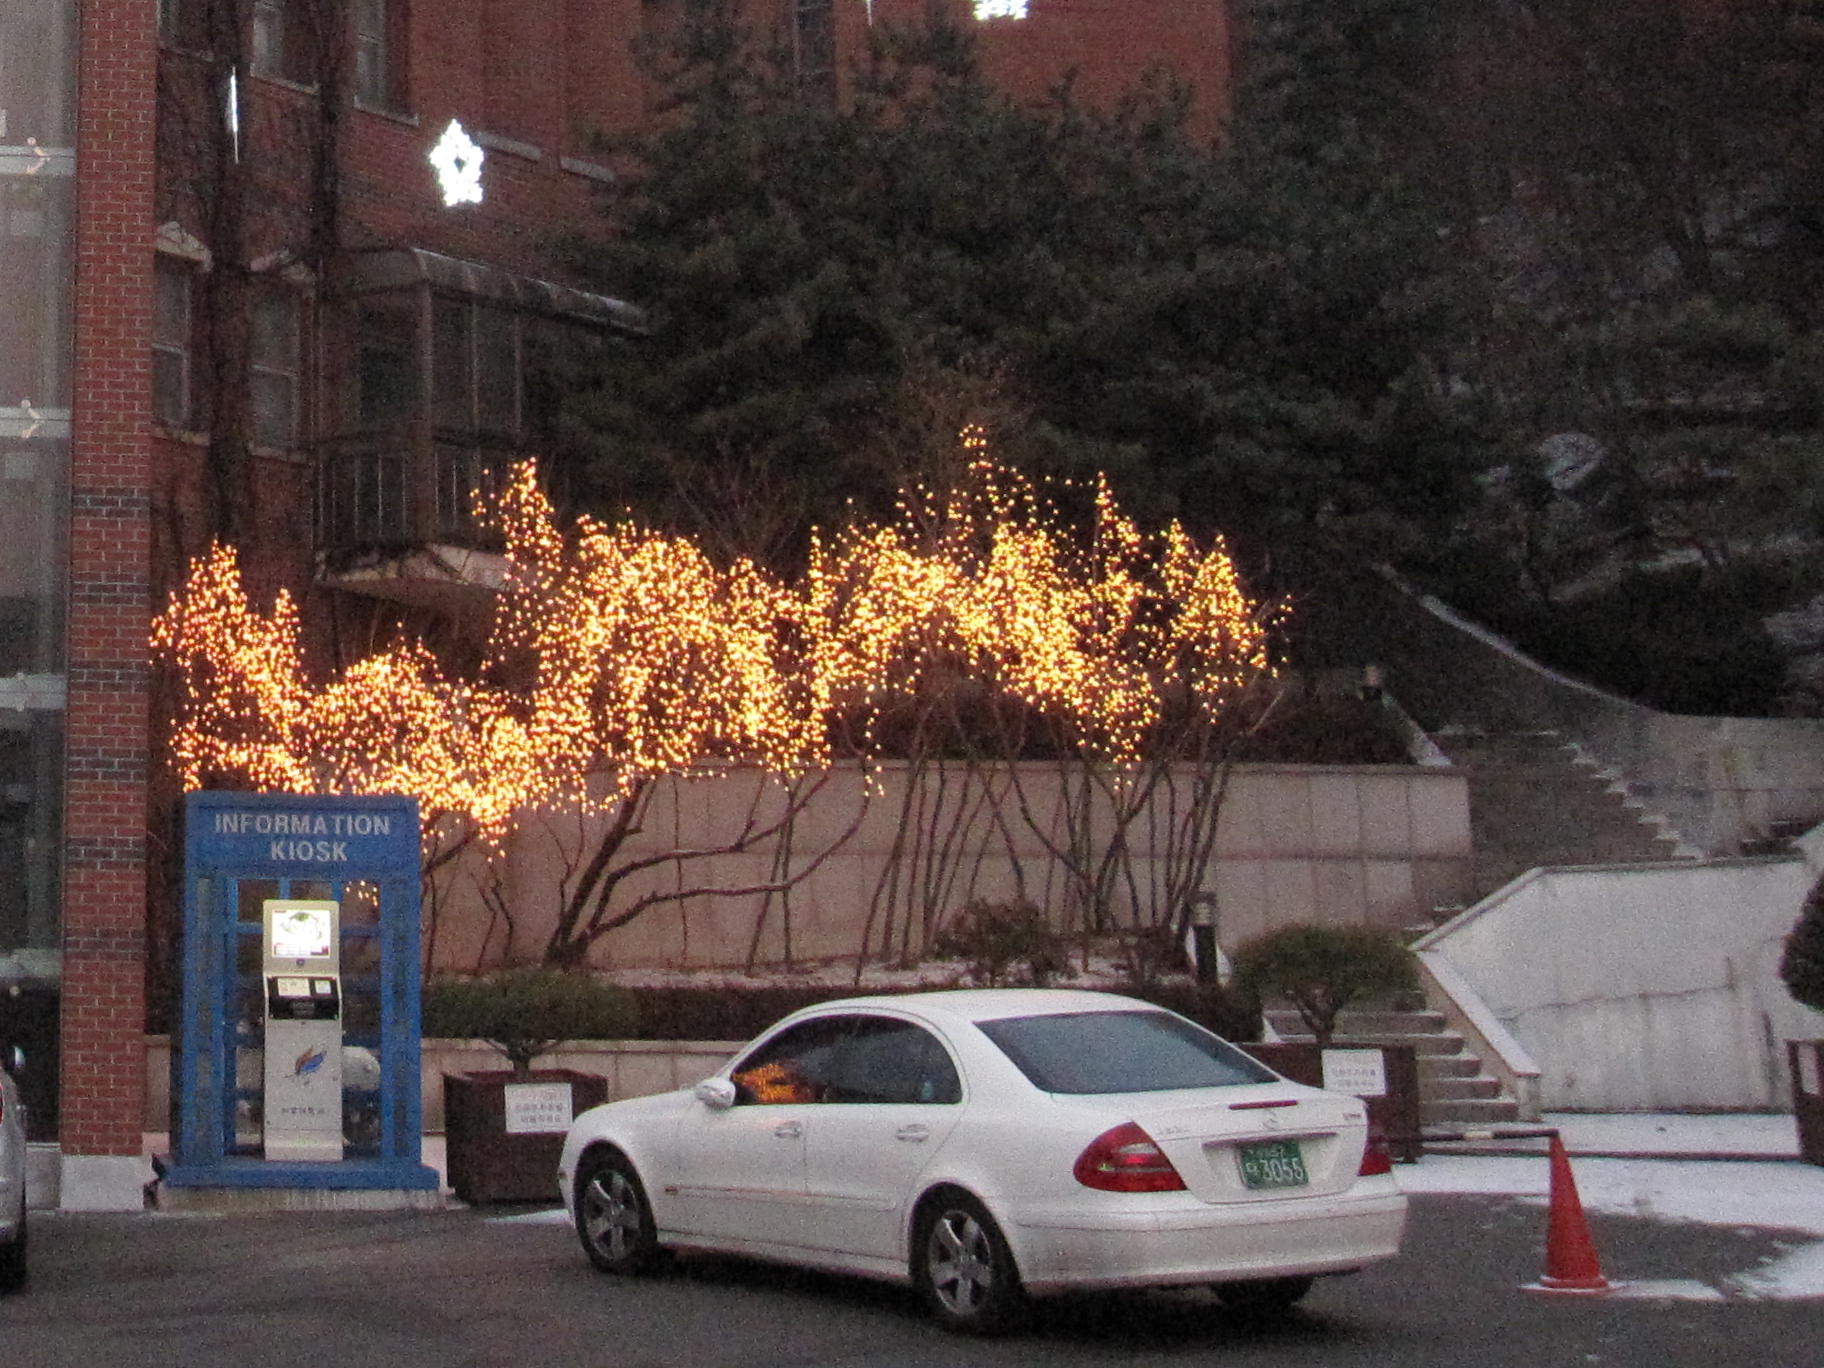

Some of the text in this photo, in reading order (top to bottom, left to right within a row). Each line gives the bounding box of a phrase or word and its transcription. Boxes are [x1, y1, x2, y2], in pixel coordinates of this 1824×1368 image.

[215, 813, 391, 836] INFORMATION
[271, 840, 348, 862] KIOSK
[1260, 1157, 1304, 1182] 3055
